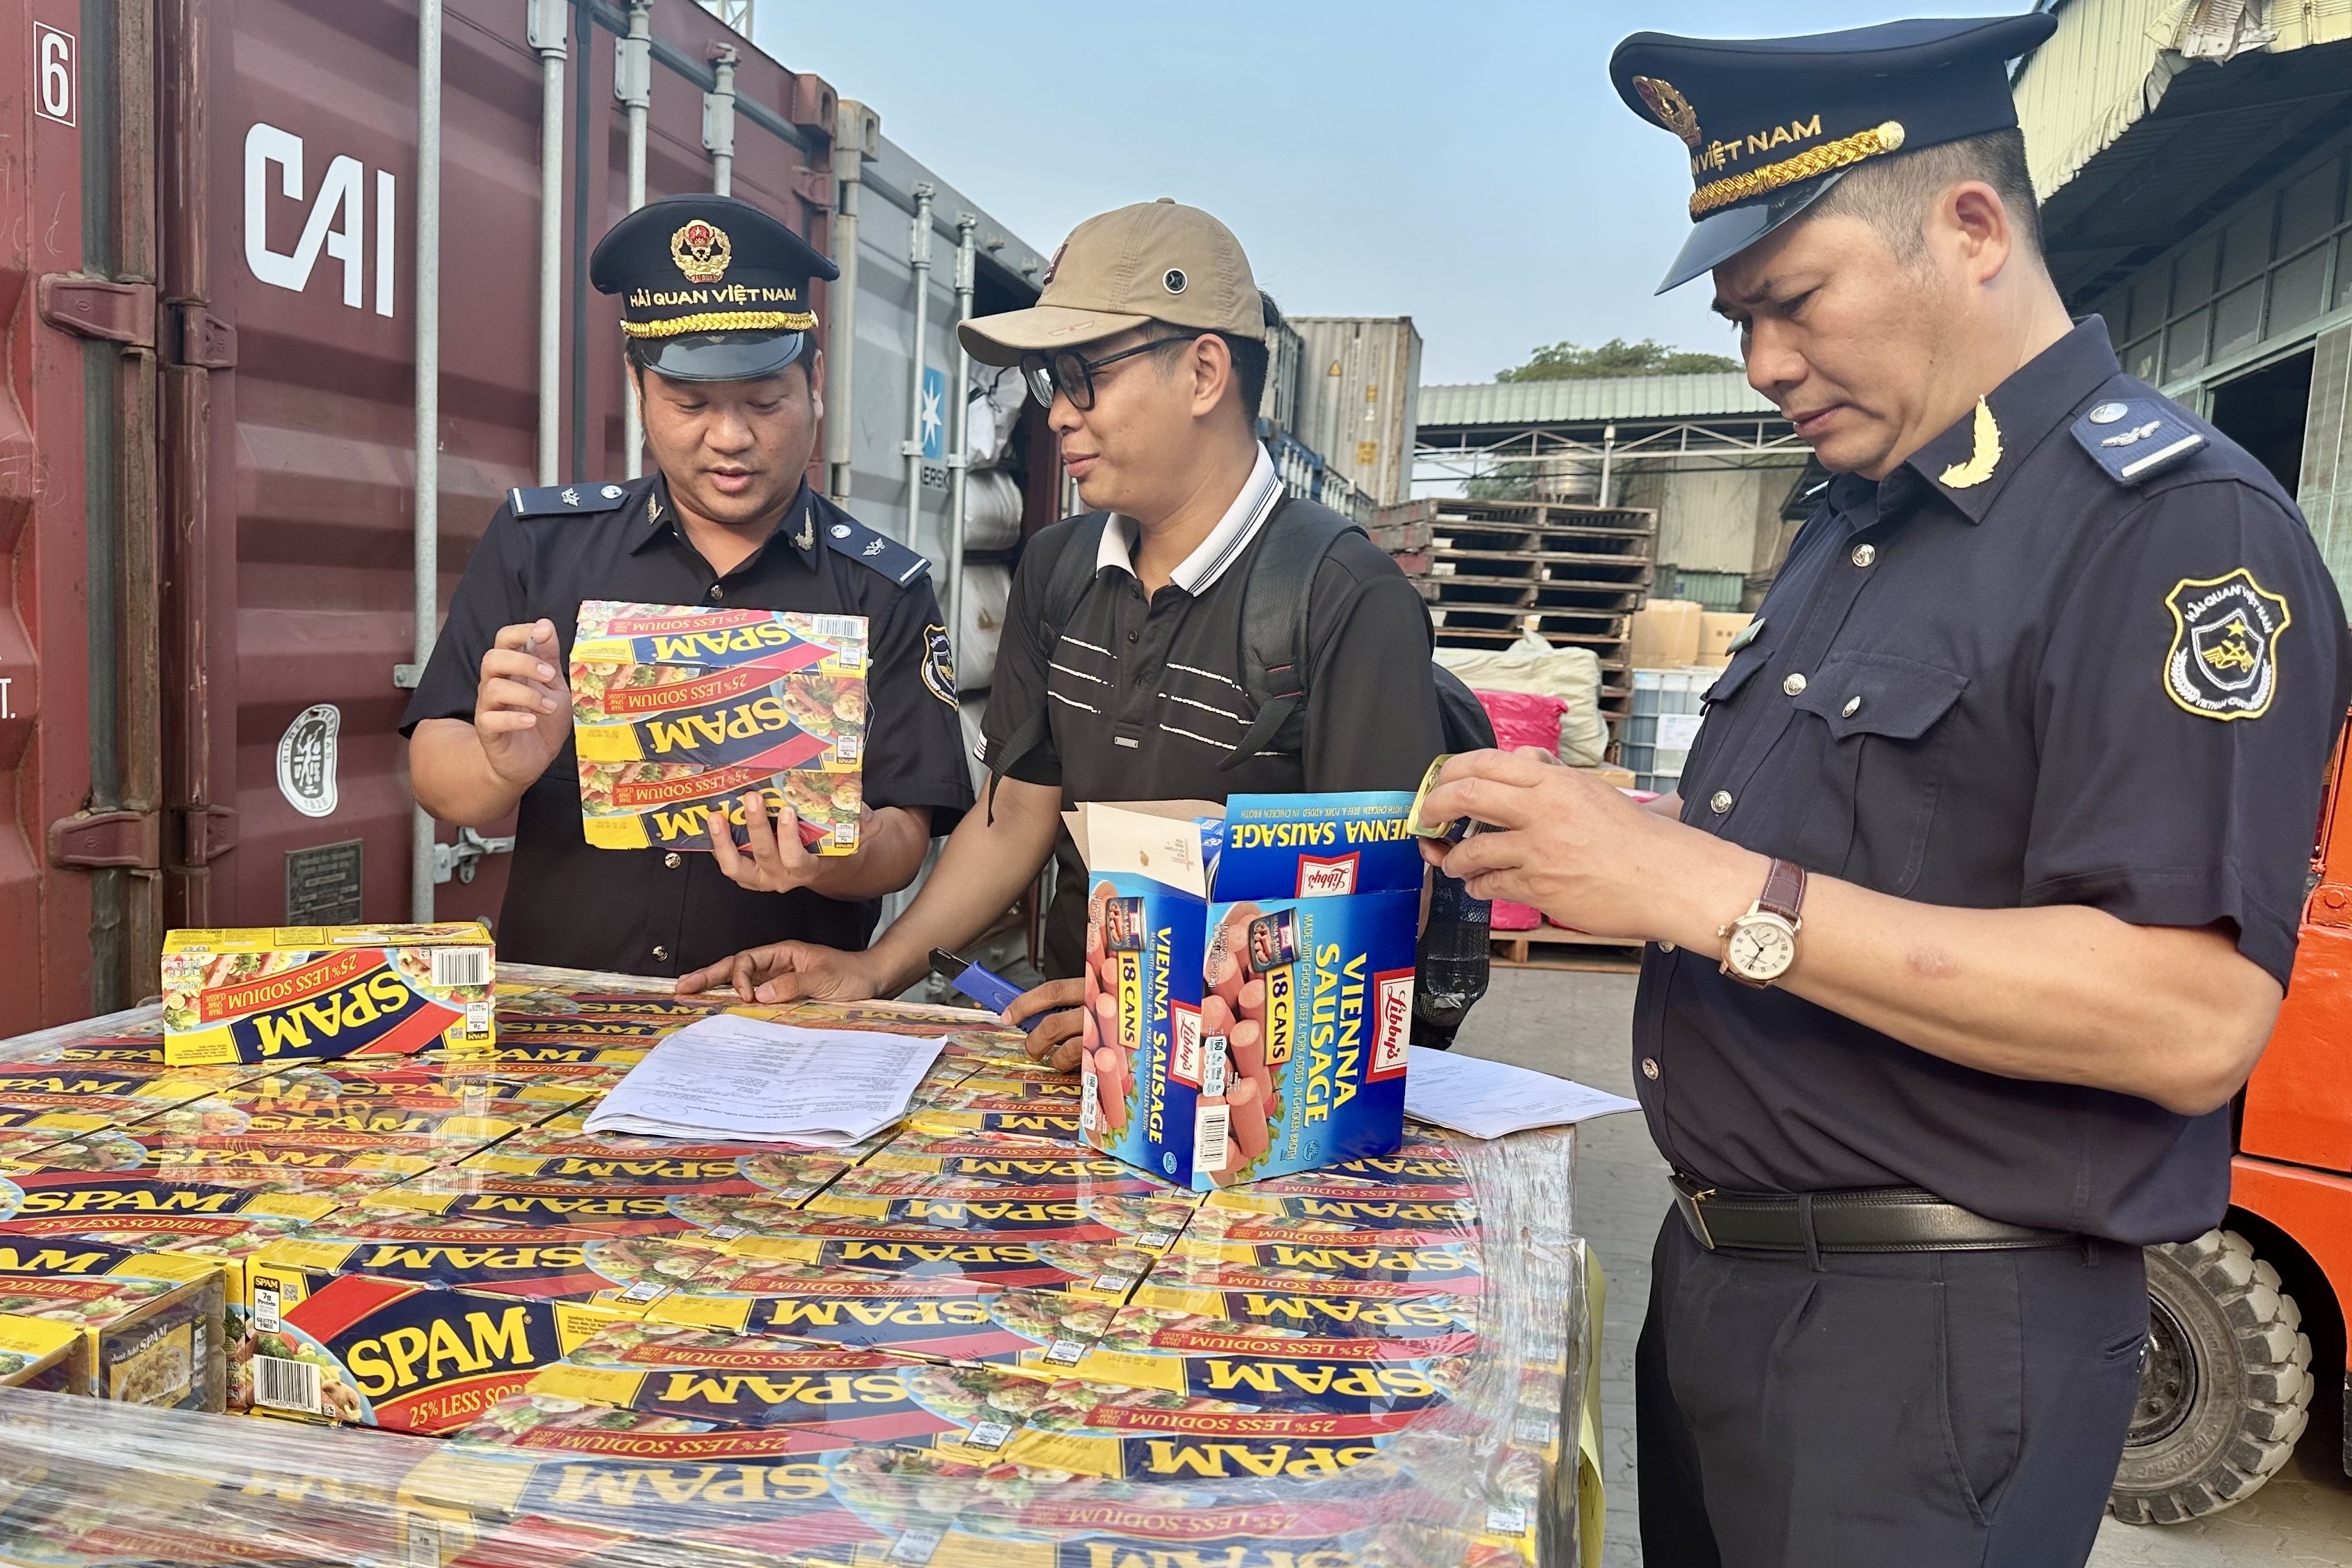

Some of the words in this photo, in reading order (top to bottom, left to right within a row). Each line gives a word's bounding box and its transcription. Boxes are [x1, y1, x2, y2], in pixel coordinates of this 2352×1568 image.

[41, 32, 69, 118] 6
[1747, 114, 1821, 154] NAM
[244, 122, 396, 318] CAI
[654, 290, 708, 306] QUAN
[762, 288, 797, 301] NAM
[726, 612, 748, 623] 25%
[2204, 585, 2242, 606] QUAN
[2257, 606, 2274, 634] NAM
[633, 620, 693, 632] SODIUM
[695, 617, 724, 627] LESS
[648, 625, 792, 661] SPAM
[690, 681, 722, 700] LESS
[724, 673, 747, 691] 25%
[627, 688, 688, 708] SODIUM
[645, 697, 789, 753] SPAM
[695, 775, 726, 793] LESS
[727, 769, 748, 783] 25%
[635, 783, 693, 801] SODIUM
[1240, 809, 1261, 818] BROTH
[1262, 809, 1290, 817] CHICKEN
[1301, 808, 1322, 817] ADDED,
[1231, 821, 1338, 848] SAUSAGE
[1308, 868, 1350, 891] Libby's
[1303, 914, 1311, 940] MADE
[1301, 942, 1310, 962] WITH
[331, 953, 359, 978] 25%
[1122, 957, 1136, 981] 18
[1153, 927, 1172, 1021] VIENNA
[295, 964, 331, 993] LESS
[1272, 972, 1288, 998] 18
[1299, 964, 1309, 1003] CHICKEN,
[205, 992, 226, 1002] CLASSIC
[227, 977, 293, 1010] SODIUM
[253, 971, 409, 1056] SPAM
[579, 1003, 712, 1015] SPAM
[1124, 986, 1136, 1043] CANS
[1299, 1003, 1307, 1022] BEEF
[503, 1022, 657, 1035] SPAM
[1273, 1003, 1288, 1059] CANS
[1333, 952, 1367, 1111] VIENNA
[1386, 989, 1408, 1059] Libby's
[1181, 1018, 1198, 1072] Libby's
[1296, 1033, 1306, 1053] PORK
[1303, 943, 1340, 1128] SAUSAGE
[517, 1065, 582, 1074] SODIUM
[1293, 1056, 1303, 1085] ADDED,
[1149, 1030, 1167, 1144] SAUSAGE
[1294, 1088, 1302, 1096] IN
[991, 1100, 1048, 1112] SODIUM
[1290, 1097, 1301, 1133] CHICKEN
[952, 1145, 1019, 1157] SODIUM
[1026, 1148, 1060, 1157] LESS
[1287, 1134, 1299, 1160] BROTH
[551, 1159, 740, 1178] SPAM
[959, 1158, 1127, 1176] SPAM
[560, 1186, 609, 1196] LESS
[976, 1189, 1019, 1198] LESS
[1023, 1189, 1051, 1198] 25%
[1284, 1185, 1352, 1196] SODIUM
[1359, 1189, 1397, 1198] LESS
[1400, 1190, 1429, 1199] 25%
[15, 1190, 242, 1212] SPAM
[465, 1194, 668, 1214] SPAM
[907, 1199, 1088, 1221] SPAM
[1299, 1198, 1474, 1220] SPAM
[71, 1219, 127, 1230] LESS
[126, 1219, 217, 1231] SODIUM
[835, 1227, 918, 1239] SODIUM
[473, 1231, 523, 1240] LESS
[1257, 1230, 1333, 1244] SODIUM
[1337, 1234, 1377, 1244] LESS
[362, 1246, 585, 1269] SPAM
[838, 1241, 1039, 1262] SPAM
[1272, 1246, 1461, 1271] SPAM
[256, 1277, 278, 1288] SPAM
[767, 1280, 859, 1294] SODIUM
[861, 1283, 912, 1294] LESS
[1228, 1276, 1310, 1290] SODIUM
[1317, 1282, 1358, 1294] LESS
[262, 1292, 271, 1301] 7g
[765, 1299, 987, 1326] SPAM
[1243, 1294, 1455, 1326] SPAM
[111, 1354, 125, 1362] Just
[139, 1323, 168, 1352] SPAM
[347, 1306, 535, 1396] SPAM
[1189, 1336, 1283, 1353] SODIUM
[1287, 1343, 1335, 1355] LESS
[1339, 1343, 1377, 1356] 25%
[662, 1351, 765, 1365] SODIUM
[765, 1356, 823, 1365] LESS
[826, 1356, 868, 1365] 25%
[1207, 1360, 1436, 1397] SPAM
[657, 1374, 909, 1404] SPAM
[408, 1400, 439, 1428] 25%
[440, 1390, 483, 1419] LESS
[1128, 1412, 1232, 1429] SODIUM
[1237, 1418, 1293, 1432] LESS
[1296, 1419, 1337, 1433] 25%
[554, 1435, 675, 1453] SODIUM
[676, 1438, 739, 1452] LESS
[741, 1436, 792, 1450] 25%
[548, 1464, 831, 1506] SPAM
[1068, 1507, 1182, 1530] SODIUM
[1189, 1512, 1249, 1532] LESS
